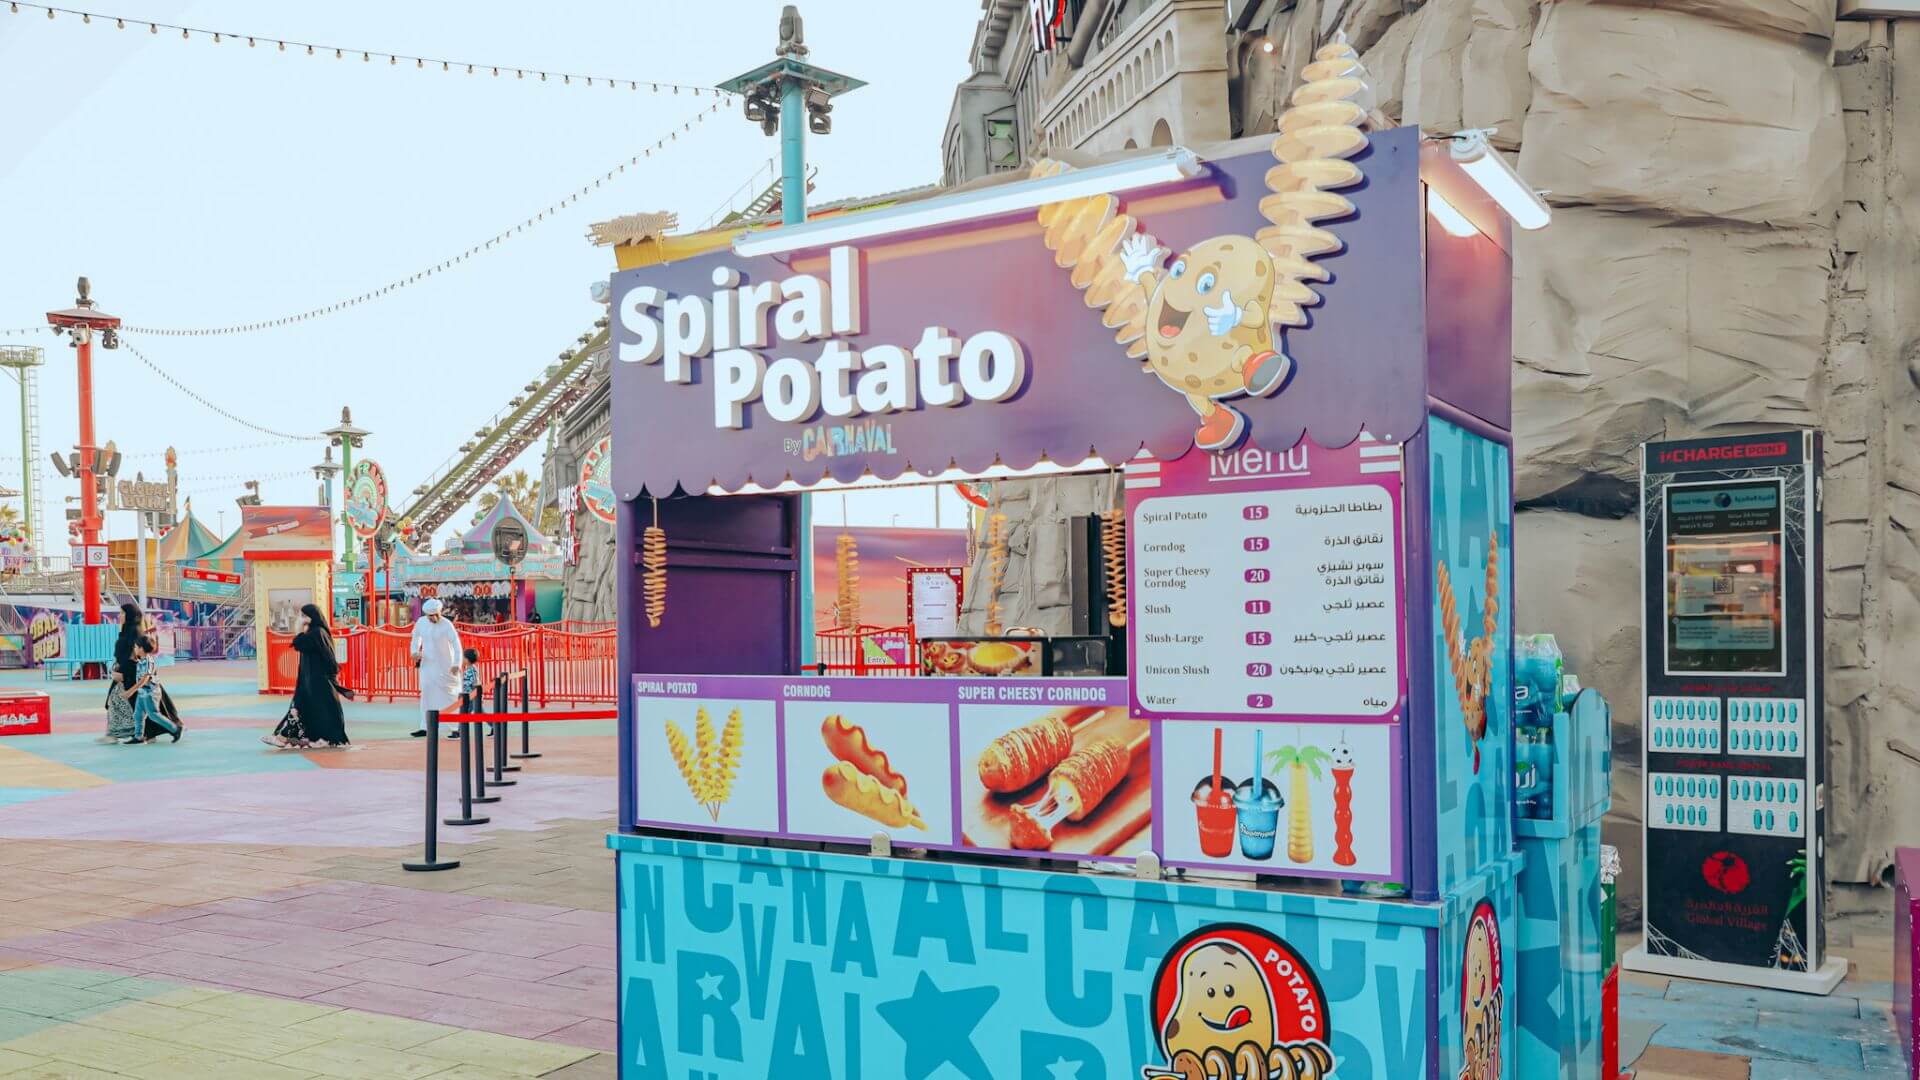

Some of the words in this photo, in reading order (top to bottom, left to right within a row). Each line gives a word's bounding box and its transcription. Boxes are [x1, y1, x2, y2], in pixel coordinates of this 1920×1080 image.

[618, 245, 862, 385] Spiral
[713, 325, 1026, 430] Potato
[783, 437, 802, 456] By
[802, 420, 897, 462] CARNAVAL
[1210, 444, 1309, 476] Menu
[1248, 507, 1264, 519] 15
[1295, 503, 1345, 516] الحلزونية
[1347, 502, 1383, 512] بطاطا
[1143, 512, 1172, 524] Spiral
[1174, 511, 1207, 521] Potato
[1249, 539, 1264, 551] 15
[1324, 535, 1350, 547] الذرة
[1143, 542, 1186, 553] Corndog
[1144, 567, 1173, 578] Super
[1175, 565, 1211, 577] Cheesy
[1250, 570, 1265, 582] 20
[1144, 578, 1187, 590] Corndog
[1325, 576, 1351, 587] الذرة
[1144, 604, 1171, 614] Slush
[1322, 597, 1353, 614] ثلجي
[1355, 599, 1385, 611] عصير
[1144, 633, 1204, 645] Slush-Large
[1251, 633, 1266, 645] 15
[1356, 632, 1386, 643] عصير
[867, 656, 888, 664] Entry
[1145, 665, 1180, 675] Unicon
[1183, 664, 1210, 675] Slush
[1252, 665, 1267, 676] 20
[1326, 662, 1355, 678] ثلجي
[1357, 664, 1387, 675] عصير
[638, 681, 665, 694] SPIRAL
[667, 682, 698, 695] POTATO
[783, 684, 832, 698] CORNDOG
[958, 686, 995, 700] SUPER
[998, 686, 1044, 701] CHEESY
[1047, 687, 1107, 701] CORNDOG
[1146, 695, 1177, 705] Water
[1362, 697, 1388, 708] مياه
[1687, 911, 1724, 926] Global
[1726, 915, 1768, 929] Village
[1264, 948, 1317, 1033] POTATO
